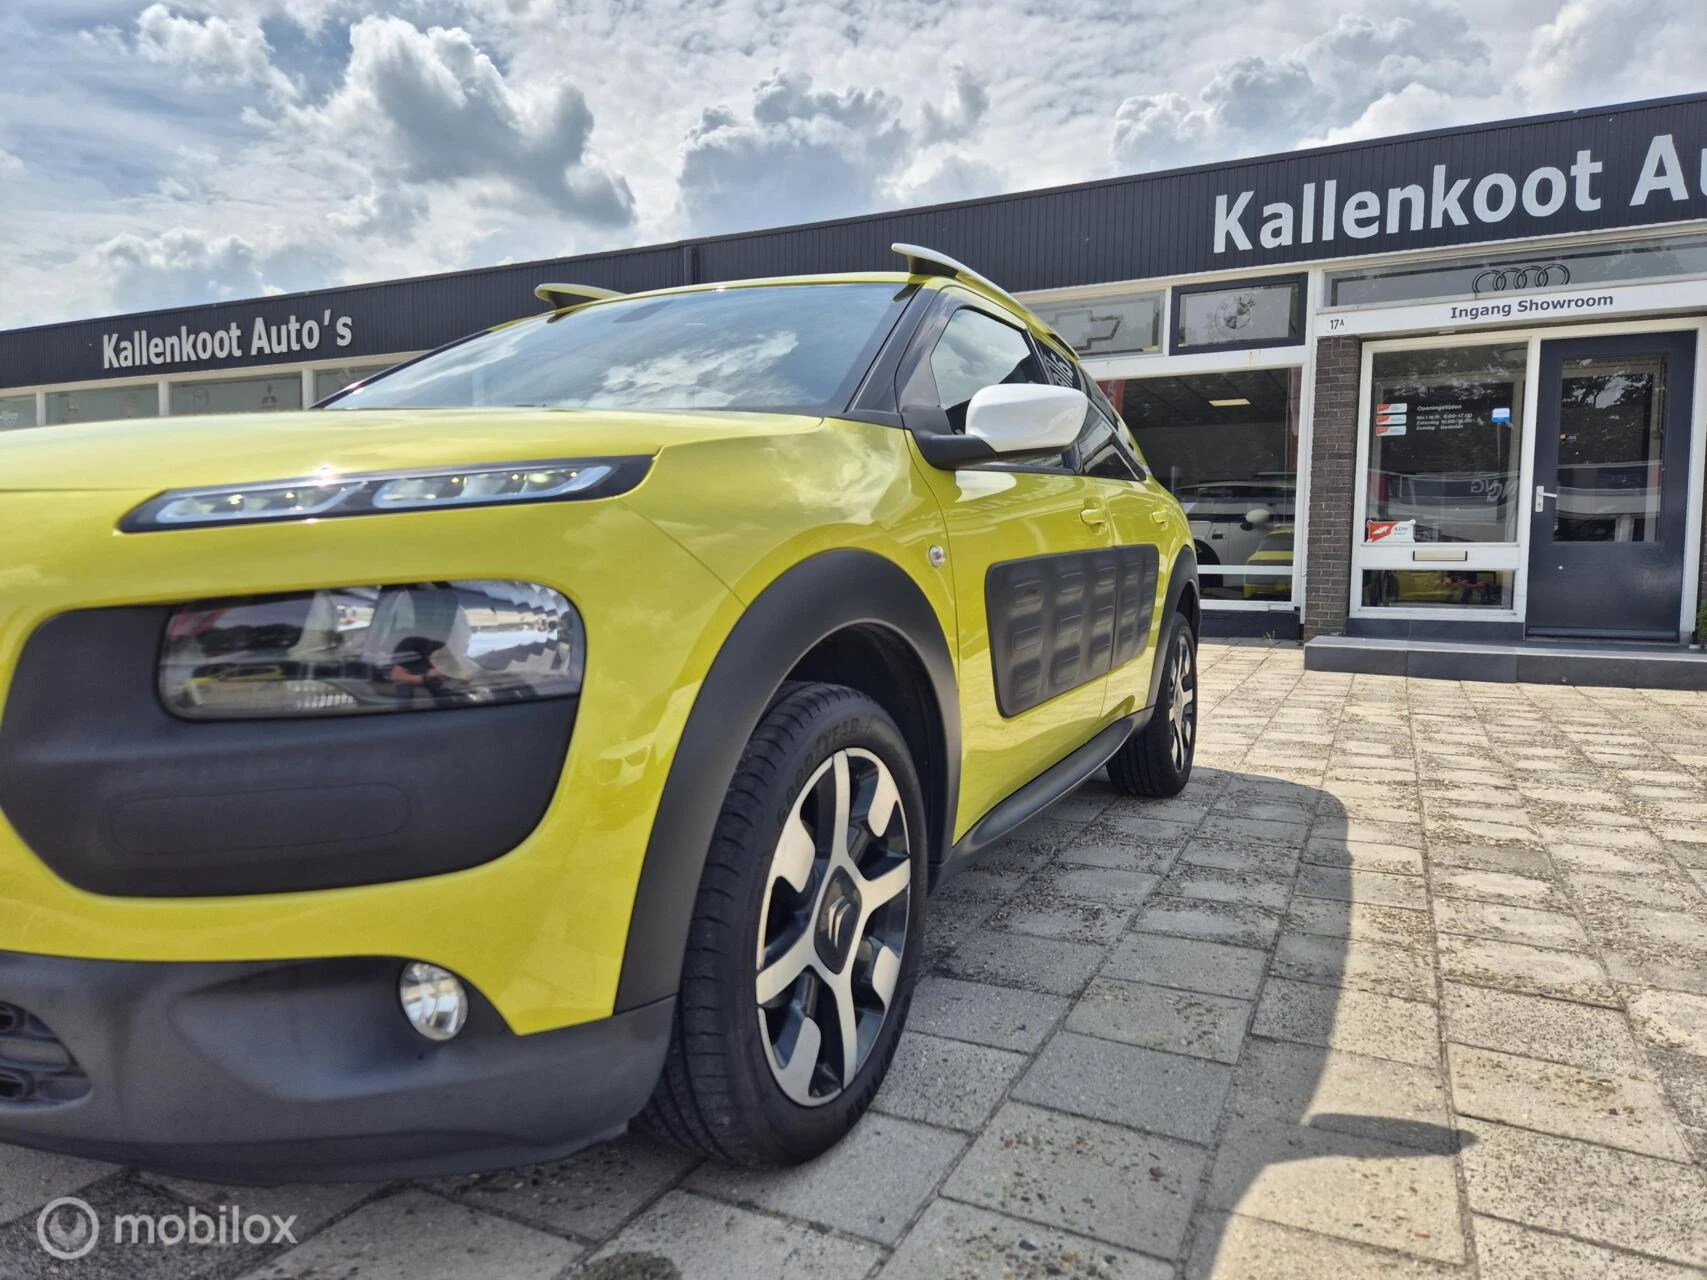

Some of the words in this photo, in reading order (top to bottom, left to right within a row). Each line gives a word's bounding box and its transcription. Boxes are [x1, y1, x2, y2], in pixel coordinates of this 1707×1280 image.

[1213, 149, 1603, 254] Kallenkoot
[1630, 134, 1707, 206] A
[1450, 303, 1512, 320] Ingang
[1517, 295, 1614, 313] Showroom
[102, 322, 243, 369] Kallenkoot
[250, 309, 353, 356] Auto's
